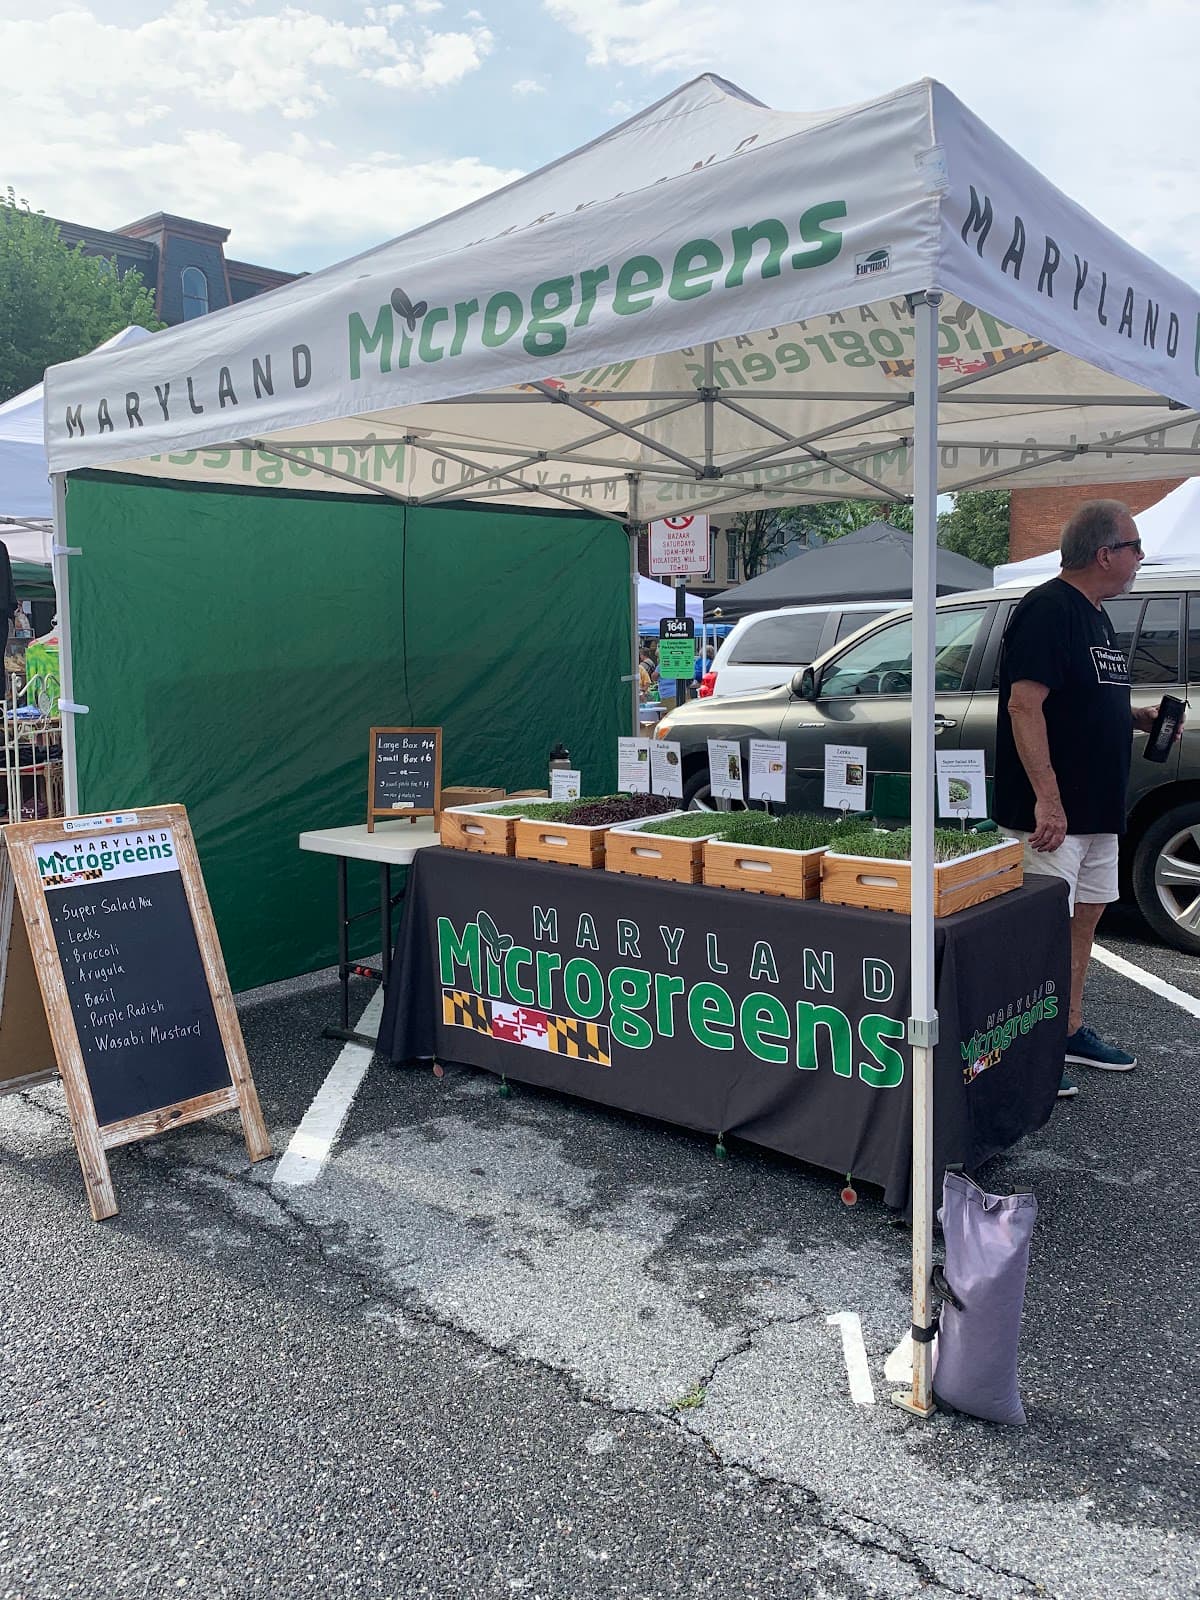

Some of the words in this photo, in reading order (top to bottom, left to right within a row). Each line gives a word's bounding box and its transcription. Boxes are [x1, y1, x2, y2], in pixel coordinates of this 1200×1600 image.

[961, 184, 1179, 359] MARYLAND
[66, 343, 312, 439] MARYLAND
[348, 200, 848, 380] Microgreens
[667, 532, 690, 540] BAZAAR
[652, 556, 681, 564] VIOLATORS
[666, 622, 687, 631] 1641
[1098, 661, 1128, 673] MARKE
[378, 737, 400, 752] Large
[402, 738, 418, 749] Box
[421, 740, 435, 750] $14
[377, 753, 399, 762] Small
[403, 753, 418, 764] Box
[74, 833, 168, 853] MARYLAND
[37, 843, 173, 876] Microgreens
[62, 904, 97, 922] Super
[101, 897, 135, 914] Salad
[139, 896, 153, 908] Mix
[68, 927, 101, 943] Leeks
[73, 944, 119, 963] Broccoli
[532, 905, 895, 1003] MARYLAND
[79, 963, 125, 982] Arugula
[84, 988, 116, 1008] Basil
[436, 916, 906, 1089] Microgreens
[90, 1009, 124, 1028] Purple
[127, 1000, 165, 1018] Radish
[95, 1030, 144, 1051] Wasabi
[150, 1020, 201, 1044] Mustard
